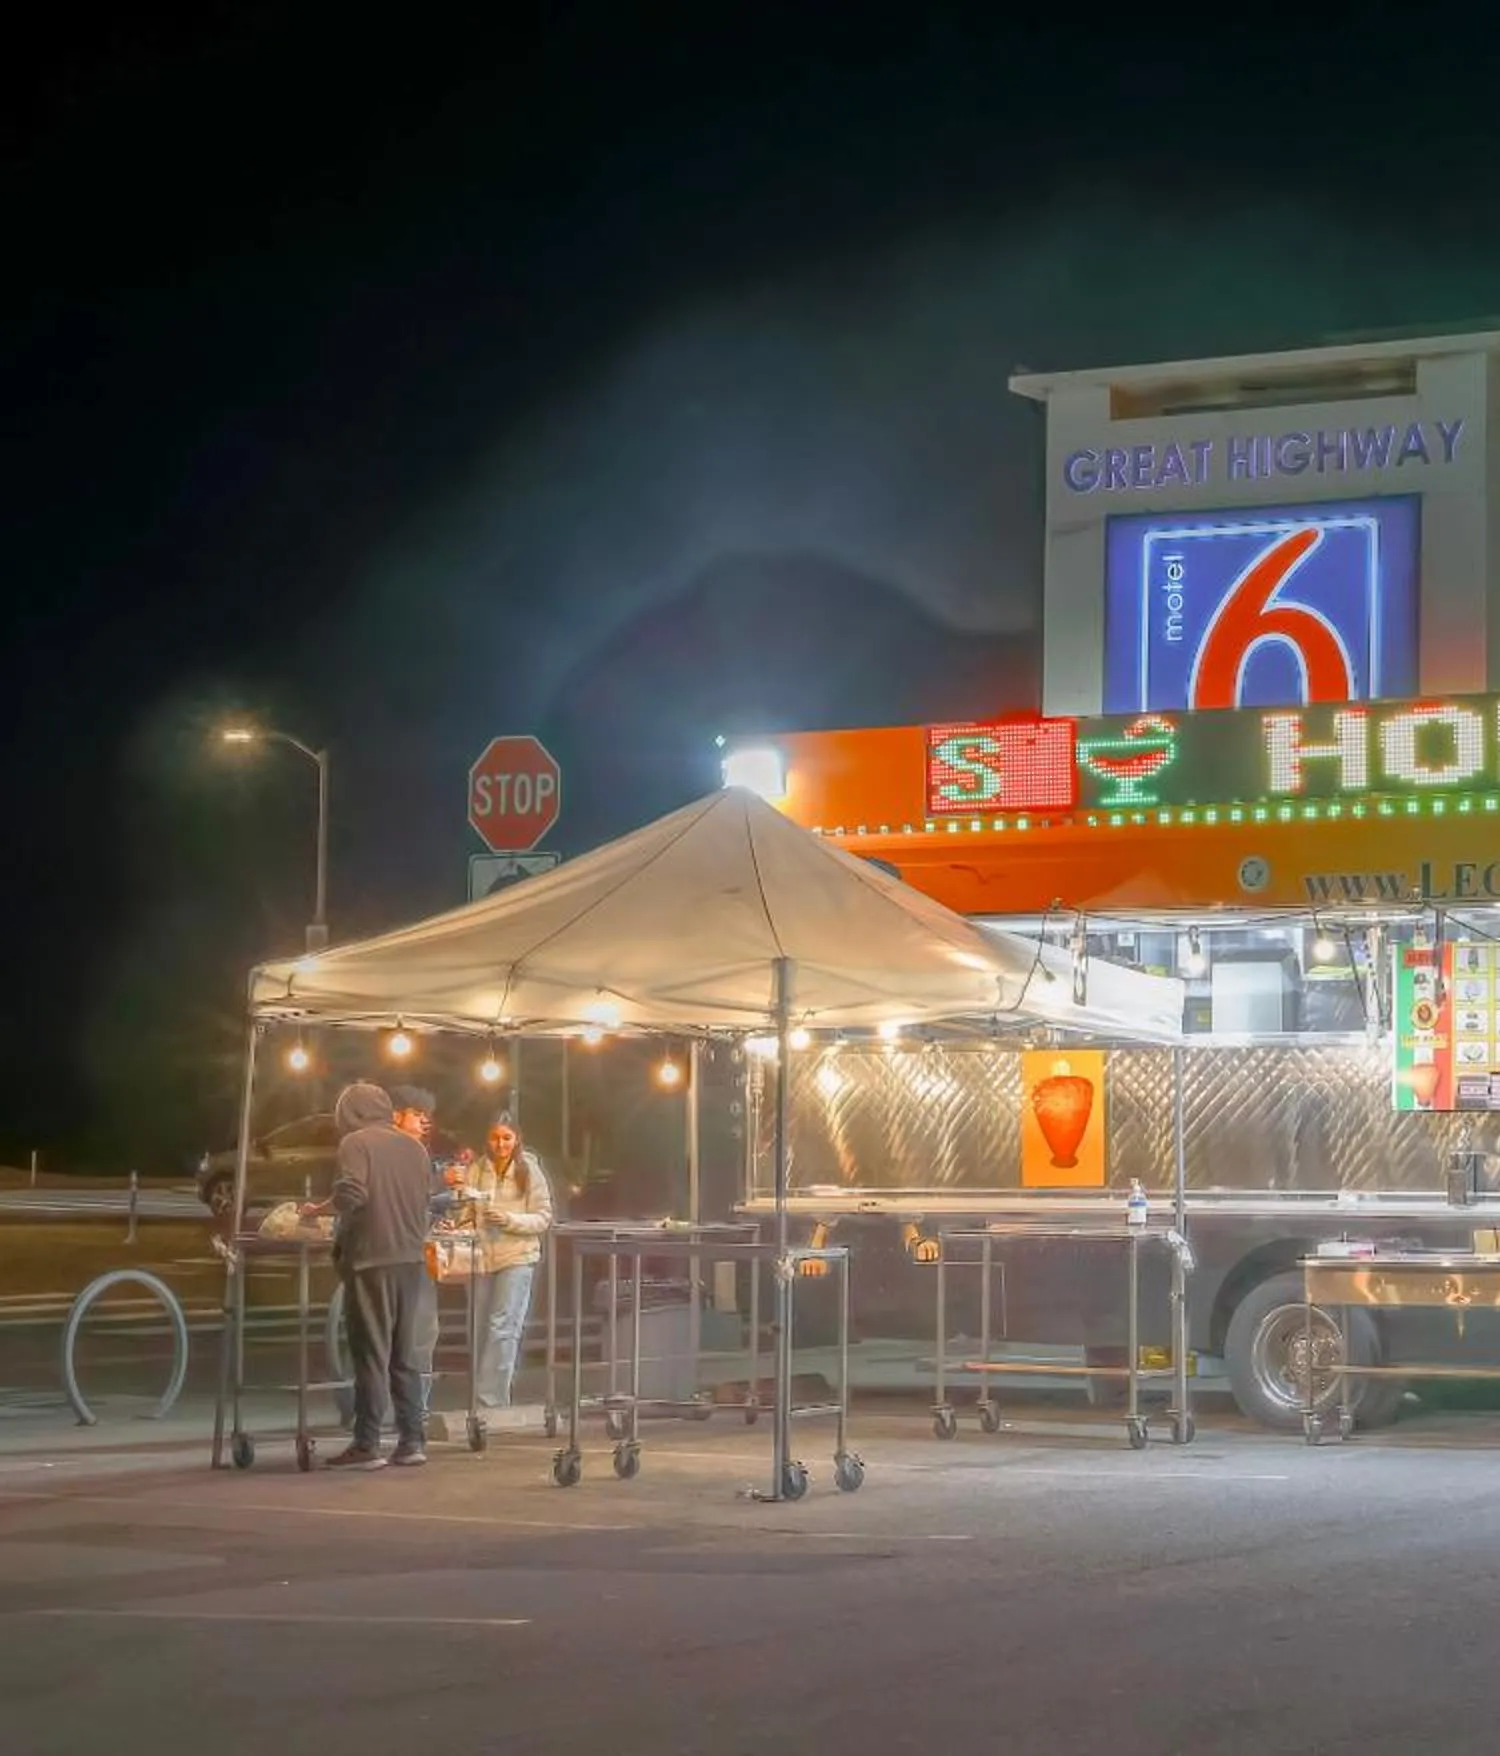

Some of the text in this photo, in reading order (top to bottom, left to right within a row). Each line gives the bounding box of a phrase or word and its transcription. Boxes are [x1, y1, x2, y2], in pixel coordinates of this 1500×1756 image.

[1063, 418, 1465, 493] GREAT HIGHWAY
[1161, 553, 1186, 643] motel
[1187, 525, 1356, 711] 6
[473, 772, 556, 816] STOP
